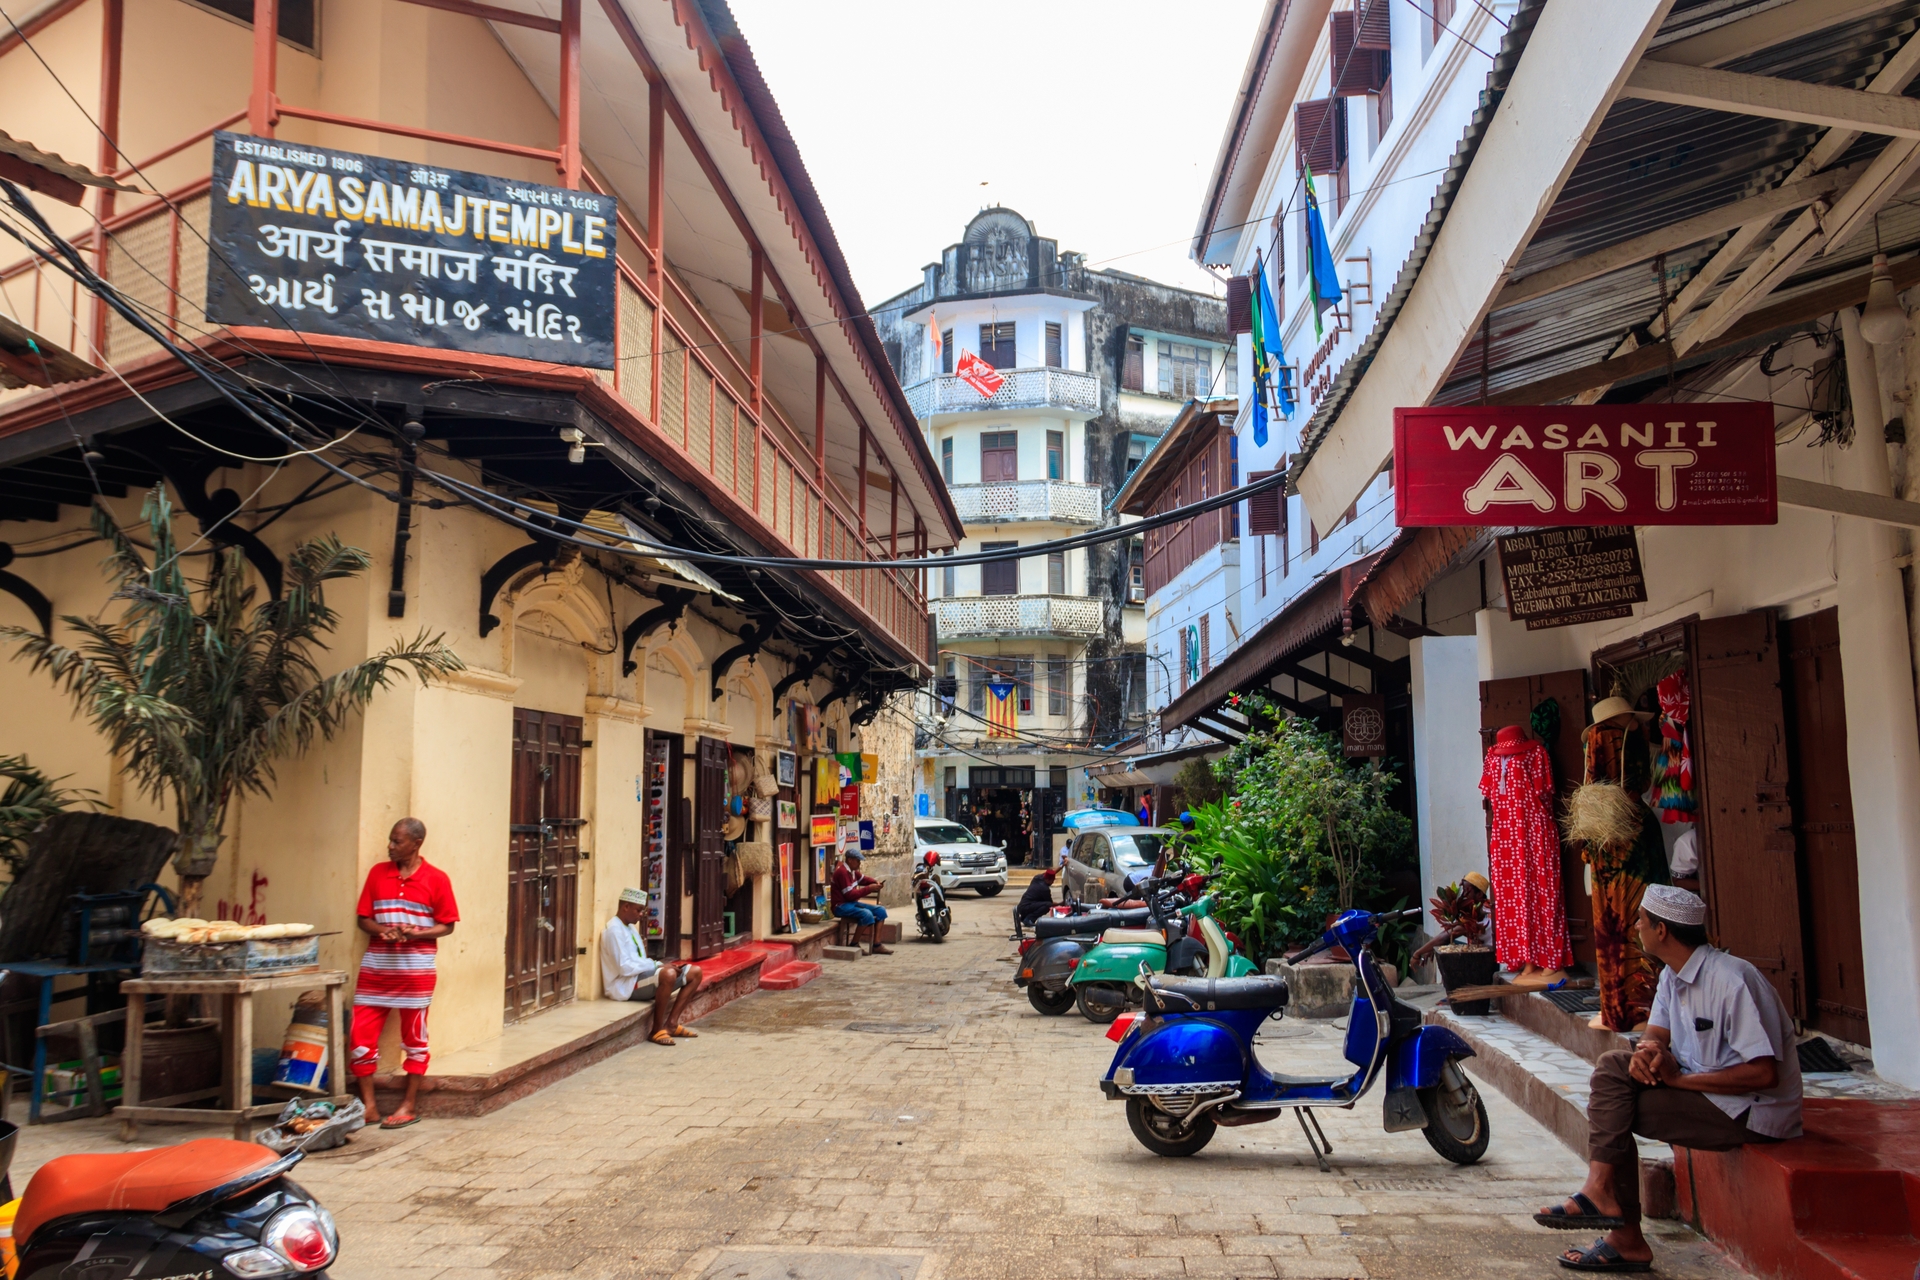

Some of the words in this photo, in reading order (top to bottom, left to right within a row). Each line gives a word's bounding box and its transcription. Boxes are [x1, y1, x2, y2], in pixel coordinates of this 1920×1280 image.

[234, 140, 327, 167] ESTABLISHED
[331, 156, 363, 174] 1906
[227, 160, 338, 219] ARYA
[338, 176, 467, 239] SAMAJ
[466, 196, 607, 259] TEMPLE
[256, 219, 351, 267] आर्य
[359, 237, 485, 285] समाज
[491, 249, 580, 298] मंदिर
[248, 273, 339, 314] આર્ય
[504, 299, 583, 344] મંદિર
[1442, 421, 1719, 451] WASANII
[1463, 448, 1699, 515] ART
[1504, 536, 1540, 553] ABBAL
[1540, 530, 1566, 546] TOUR
[1567, 529, 1588, 543] AND
[1590, 526, 1630, 539] TRAVEL
[1573, 542, 1593, 555] 177
[1514, 597, 1555, 615] GIZENGA
[1555, 595, 1576, 609] STR.
[1577, 586, 1638, 606] ZANZIBAR
[1346, 744, 1365, 752] maru
